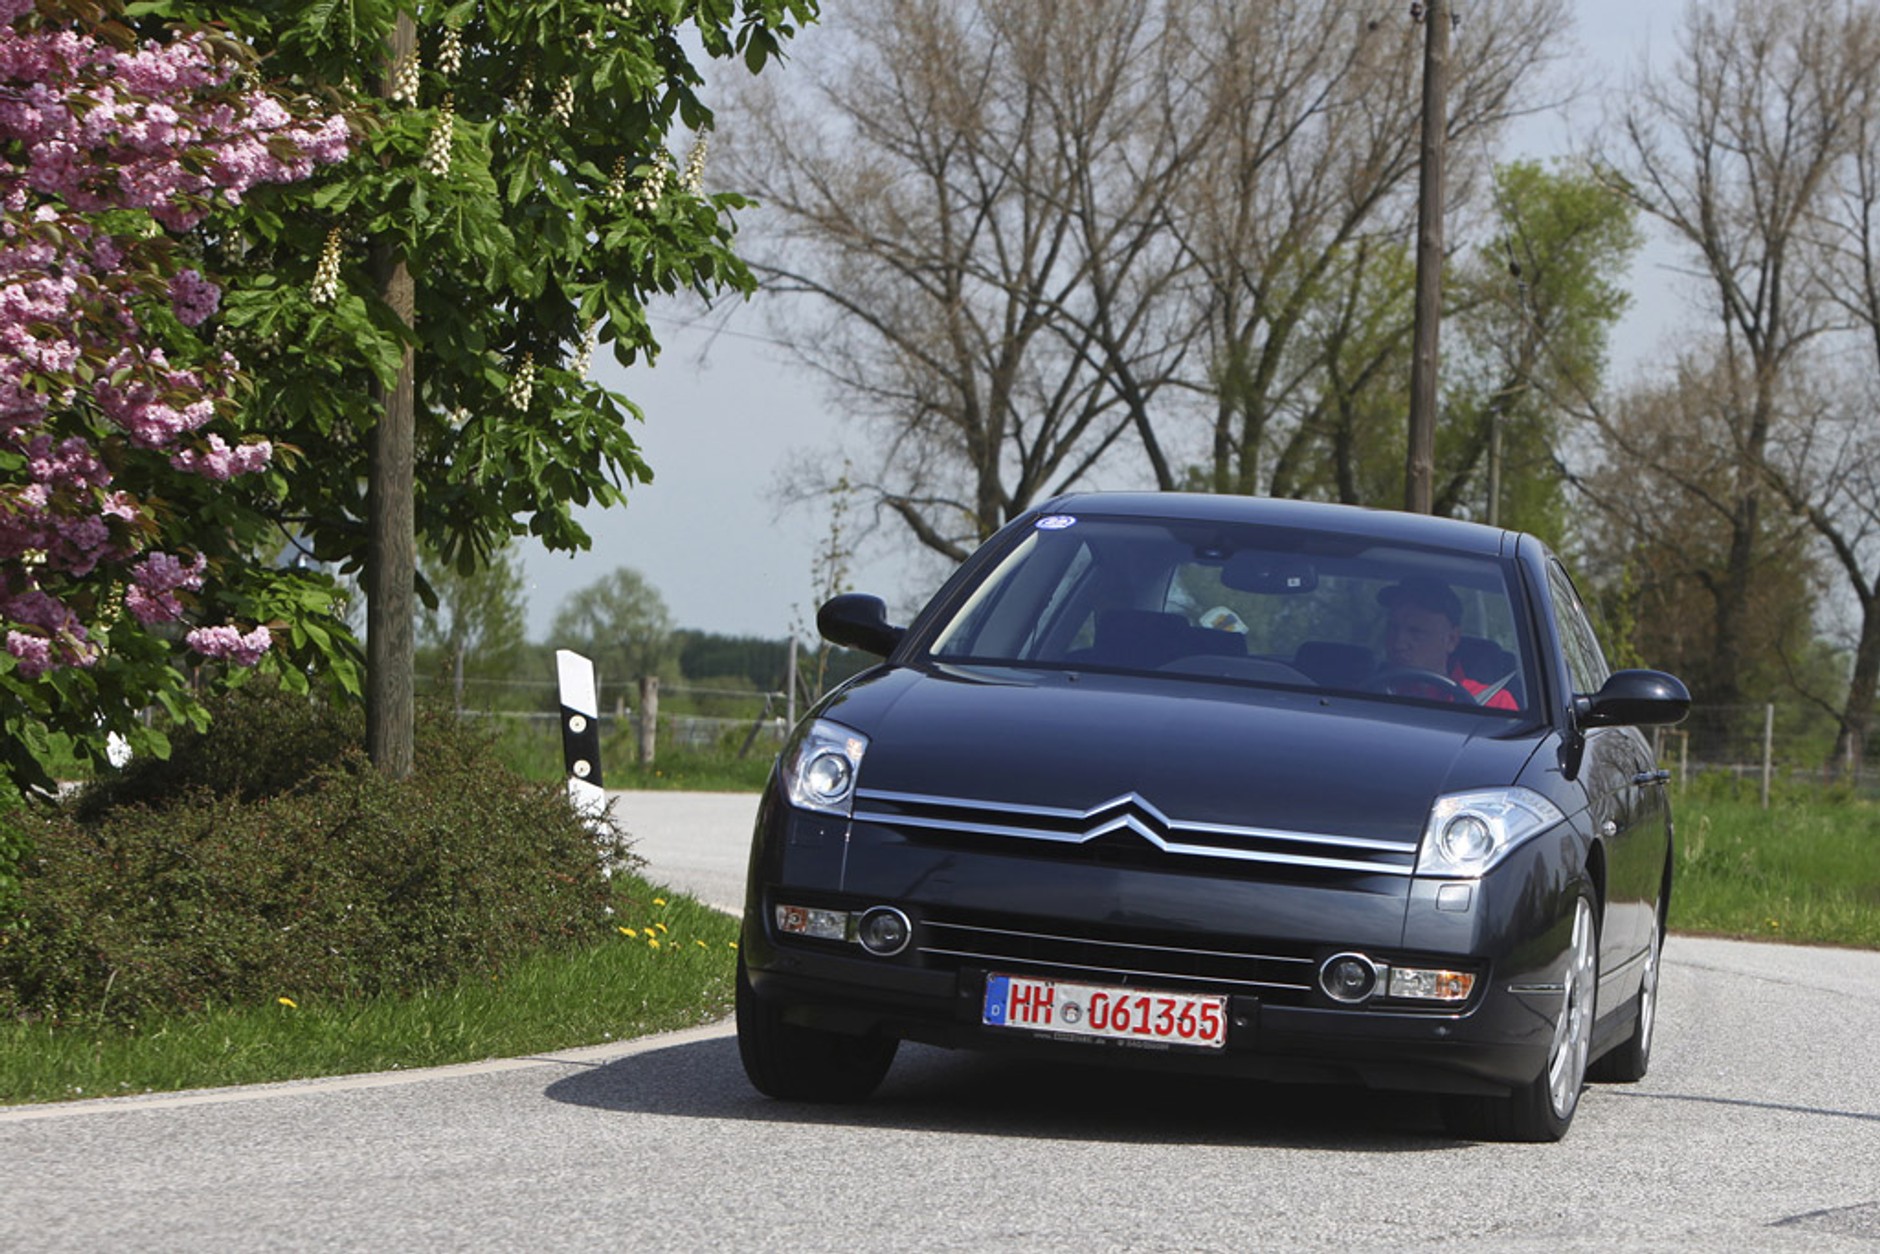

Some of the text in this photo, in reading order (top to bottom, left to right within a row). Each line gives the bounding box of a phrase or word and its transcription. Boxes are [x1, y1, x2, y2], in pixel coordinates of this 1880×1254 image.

[991, 984, 1220, 1040] D HH 061365
